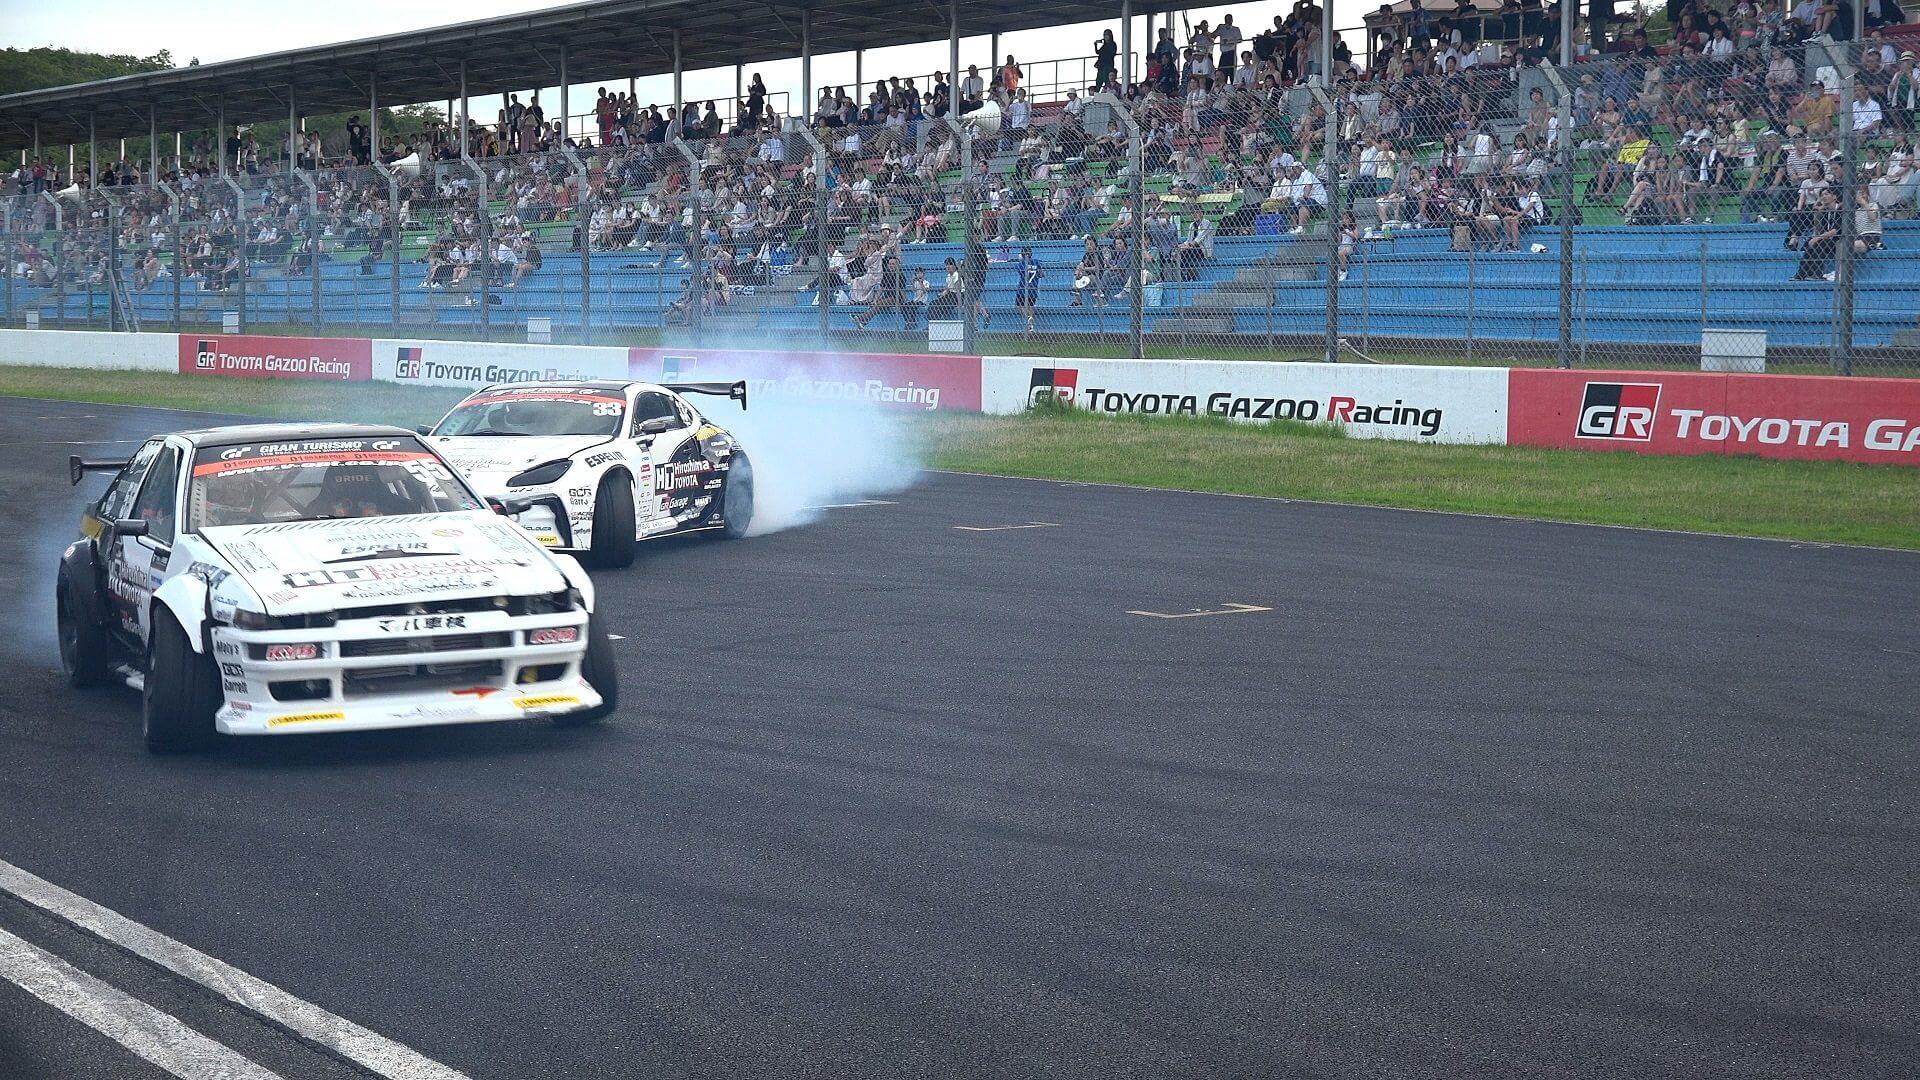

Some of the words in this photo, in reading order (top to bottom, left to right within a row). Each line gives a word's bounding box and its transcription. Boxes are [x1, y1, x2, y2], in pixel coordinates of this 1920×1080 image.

[197, 352, 215, 367] GR
[219, 354, 262, 369] TOYOTA
[265, 355, 306, 372] GAZOO
[309, 357, 350, 379] Racing
[397, 360, 419, 377] GR
[425, 361, 481, 381] TOYOTA
[865, 380, 940, 410] Racing
[592, 402, 622, 416] 33
[1085, 388, 1197, 415] TOYOTA
[1206, 392, 1319, 421] GAZOO
[1327, 396, 1442, 436] Racing
[1581, 406, 1651, 436] GR
[1670, 409, 1849, 447] TOYOTA
[260, 443, 298, 454] GRAN
[302, 440, 362, 451] TURISMO
[402, 458, 453, 482] 55
[675, 459, 710, 476] Hiroshima
[675, 474, 699, 489] TOYOTA
[669, 497, 688, 509] Garage
